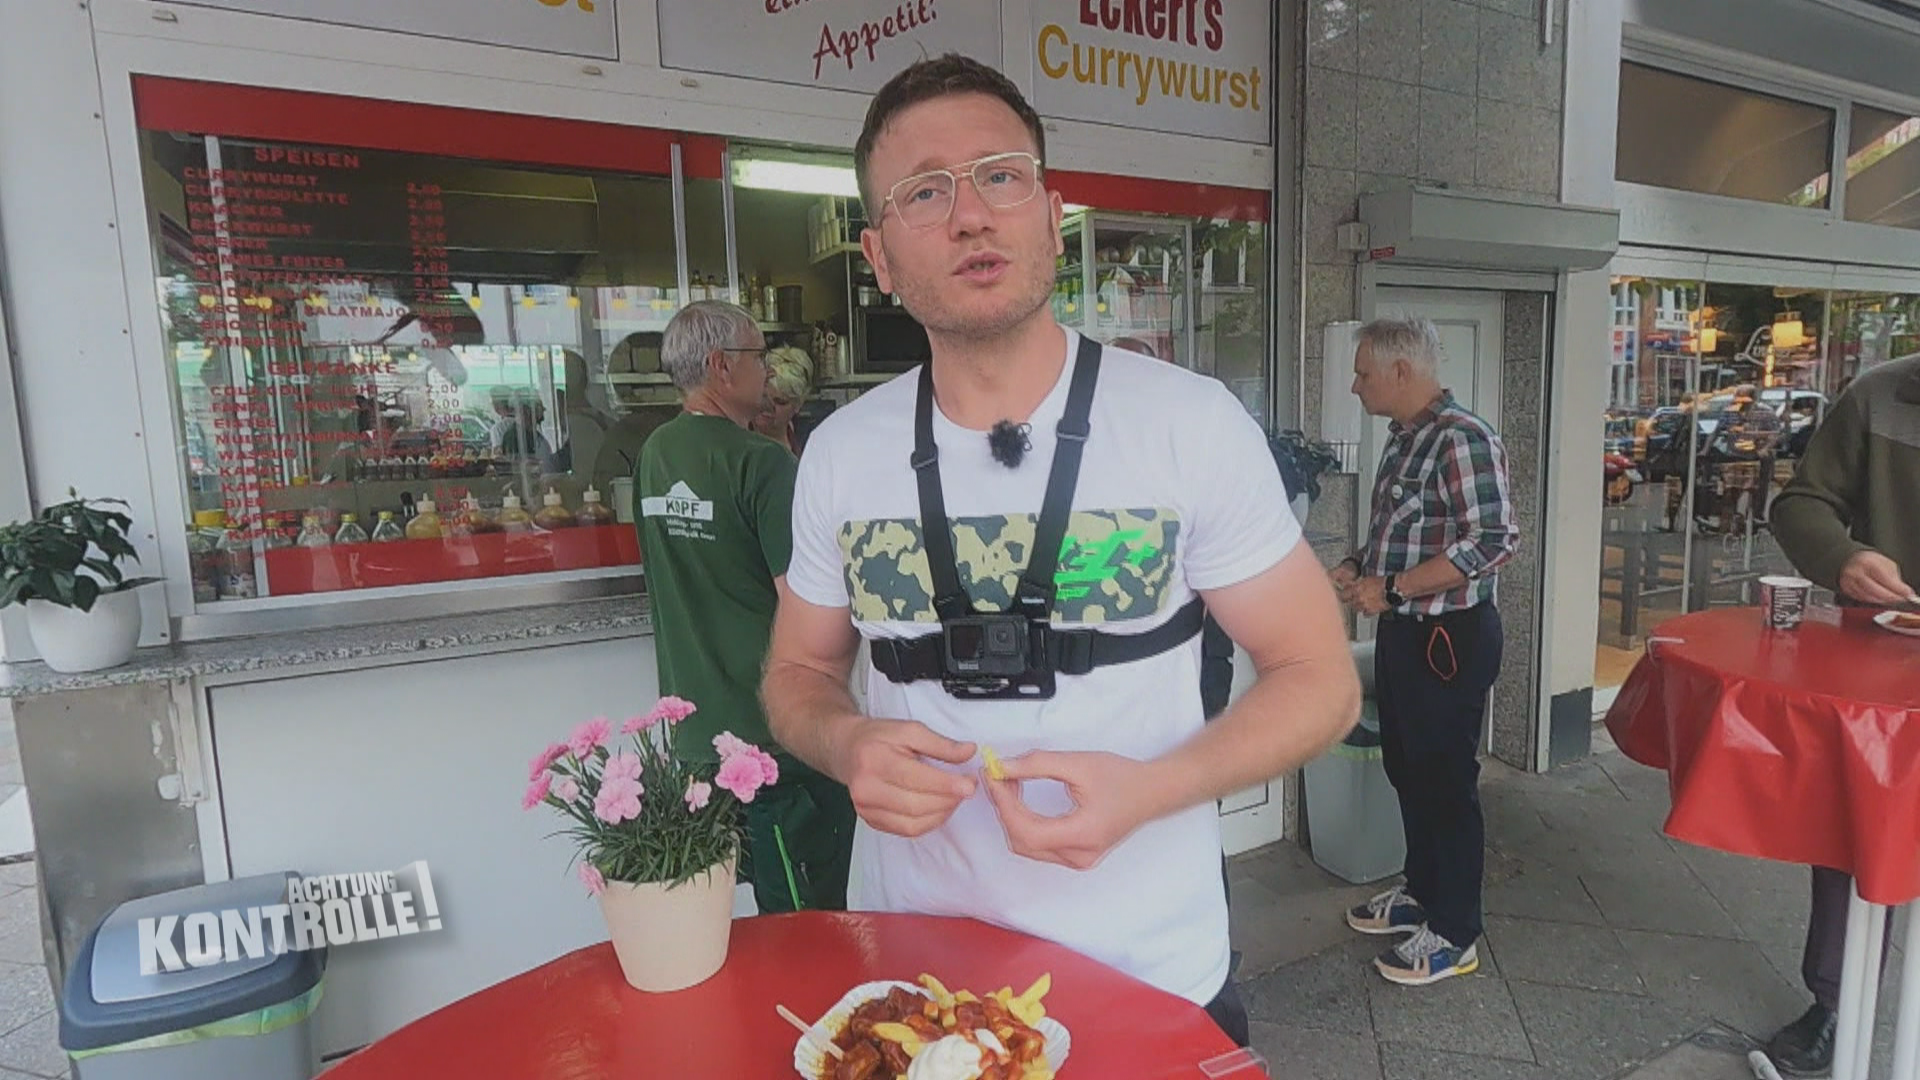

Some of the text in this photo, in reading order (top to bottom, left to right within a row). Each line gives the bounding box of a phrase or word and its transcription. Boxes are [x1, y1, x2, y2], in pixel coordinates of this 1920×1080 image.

[1038, 24, 1261, 111] Currywurst
[255, 146, 360, 168] SPEISEN
[183, 166, 319, 187] CURRYWURST
[304, 303, 407, 318] SALATMAJO
[666, 500, 700, 516] KOPF
